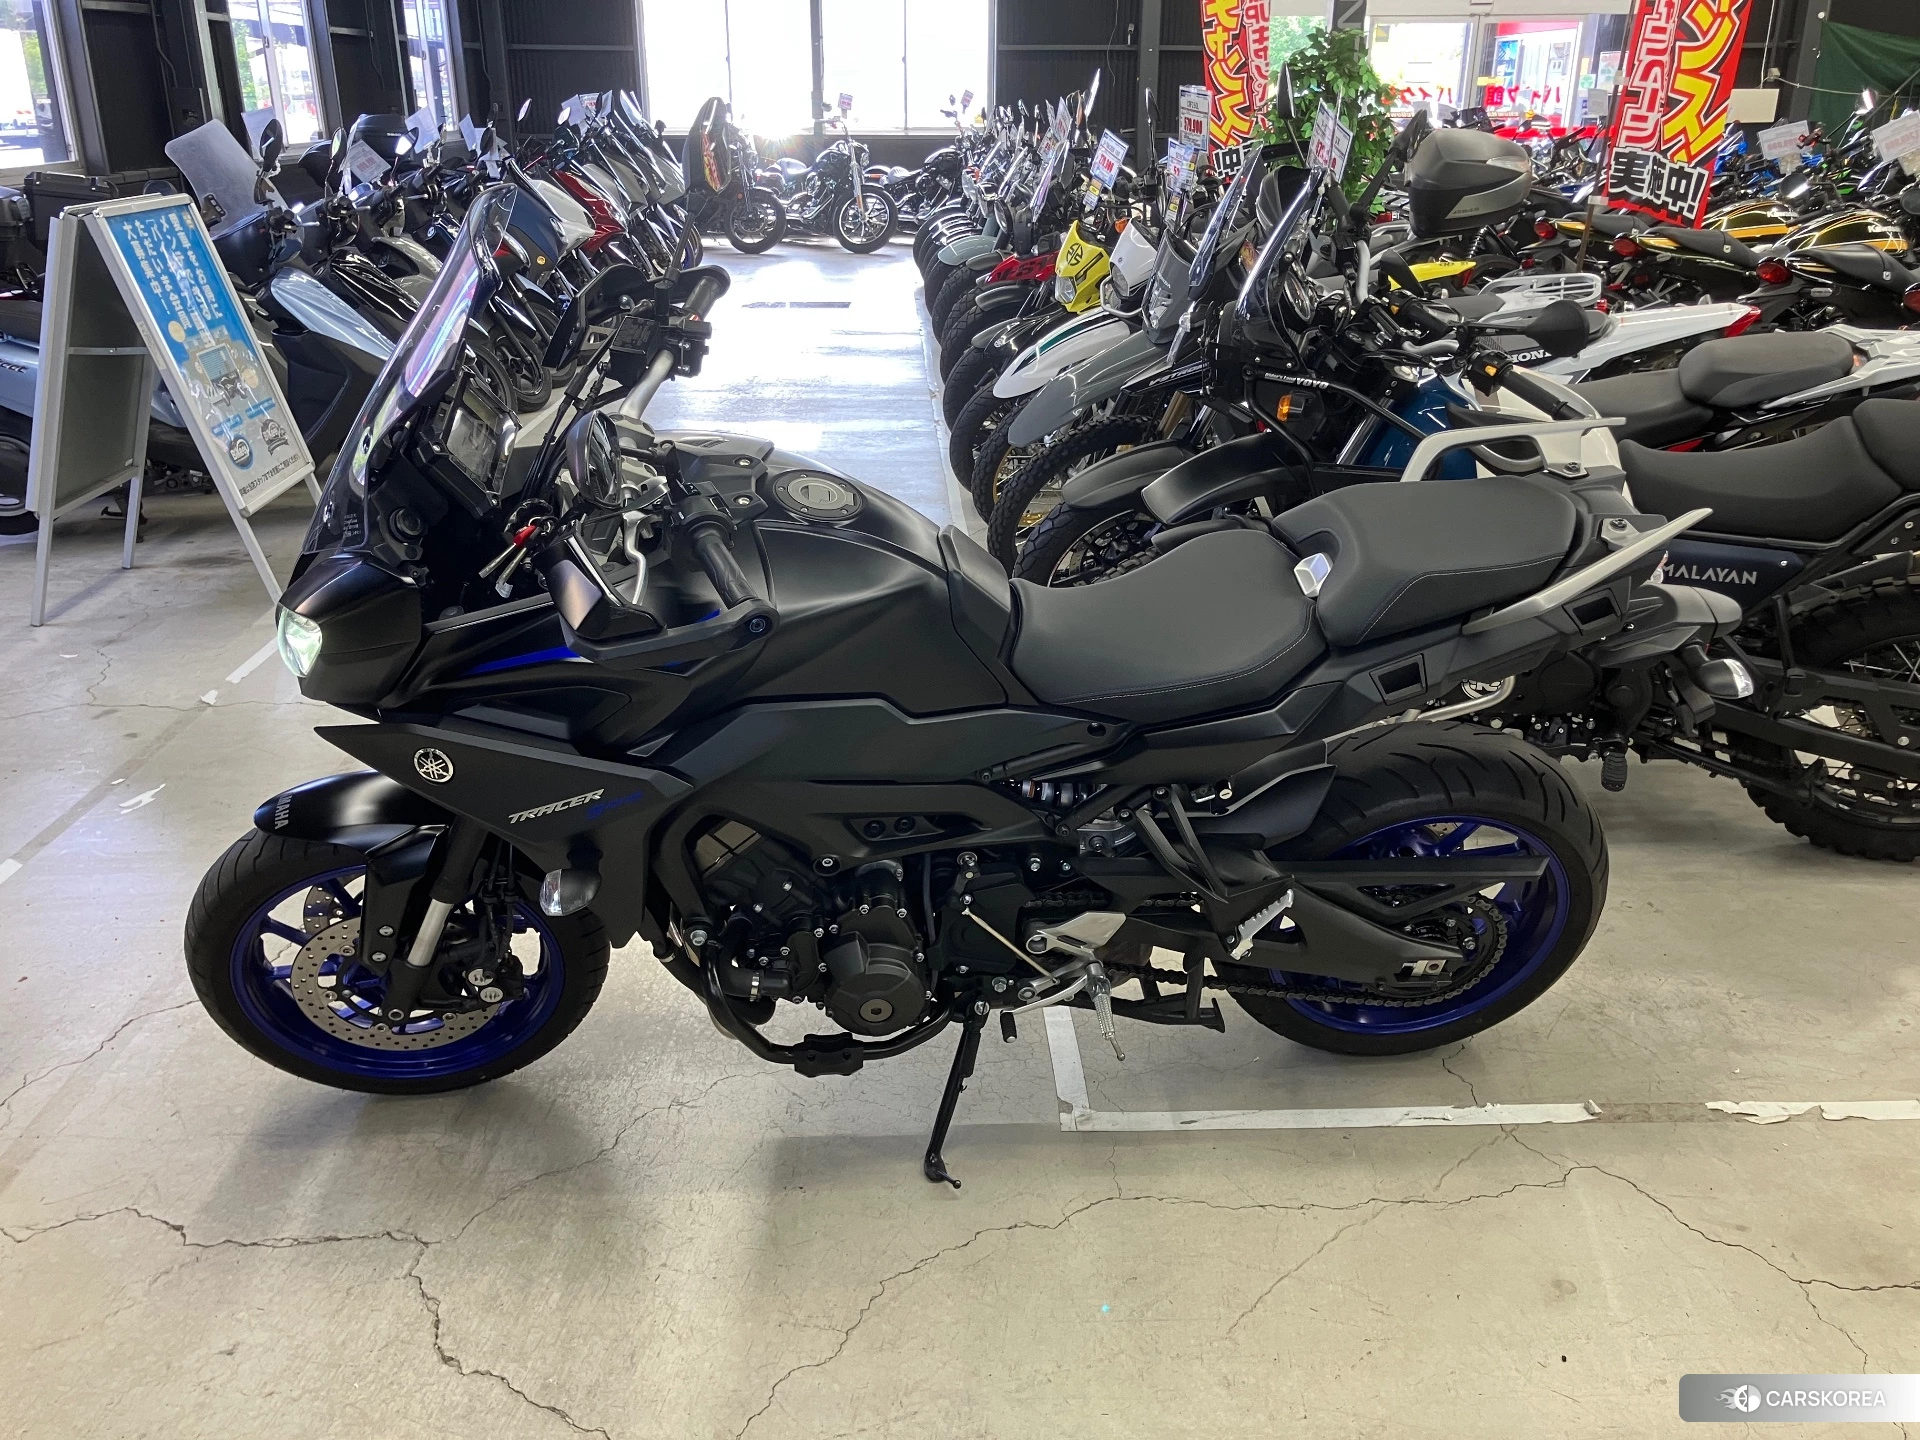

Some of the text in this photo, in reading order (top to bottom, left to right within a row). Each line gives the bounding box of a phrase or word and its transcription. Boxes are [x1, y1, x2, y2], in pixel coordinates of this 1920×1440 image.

[1609, 149, 1706, 216] 実施中!
[1296, 377, 1330, 390] YOYO
[508, 788, 605, 824] TRACER
